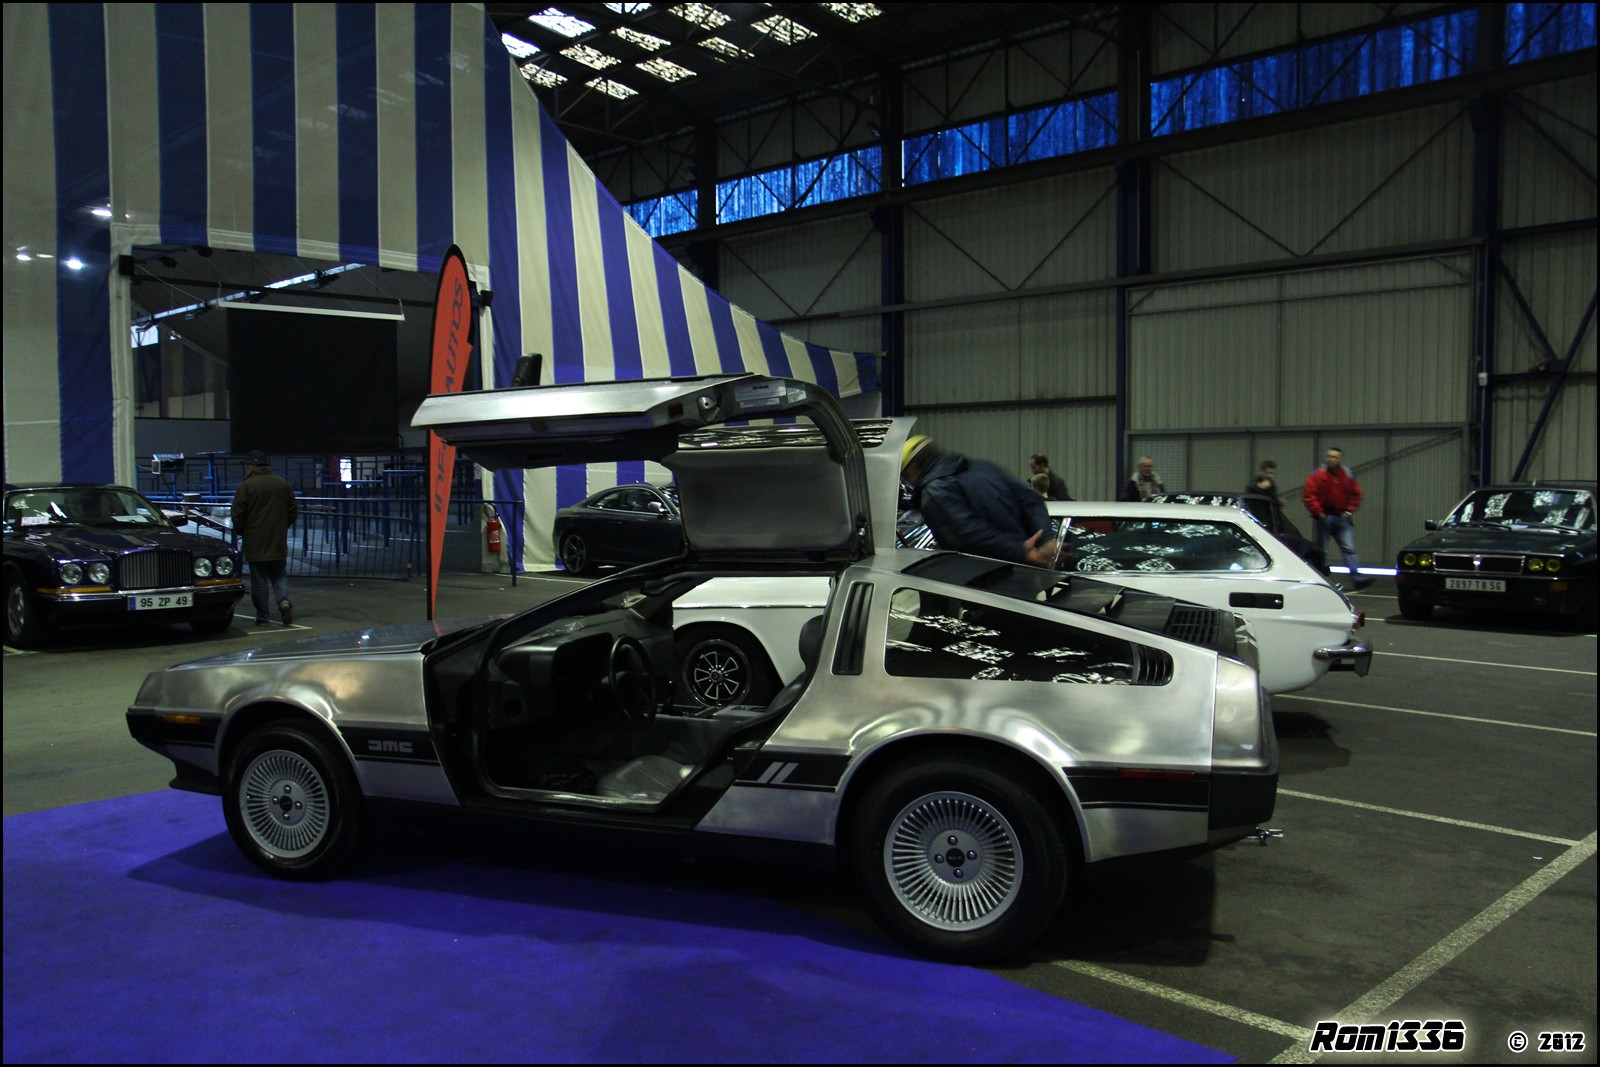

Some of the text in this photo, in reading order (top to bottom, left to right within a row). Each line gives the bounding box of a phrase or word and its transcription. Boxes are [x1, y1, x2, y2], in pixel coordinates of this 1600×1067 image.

[444, 277, 463, 393] AUTOS
[1449, 579, 1502, 591] 2097 TR 56
[140, 596, 188, 607] 95 ZP 49
